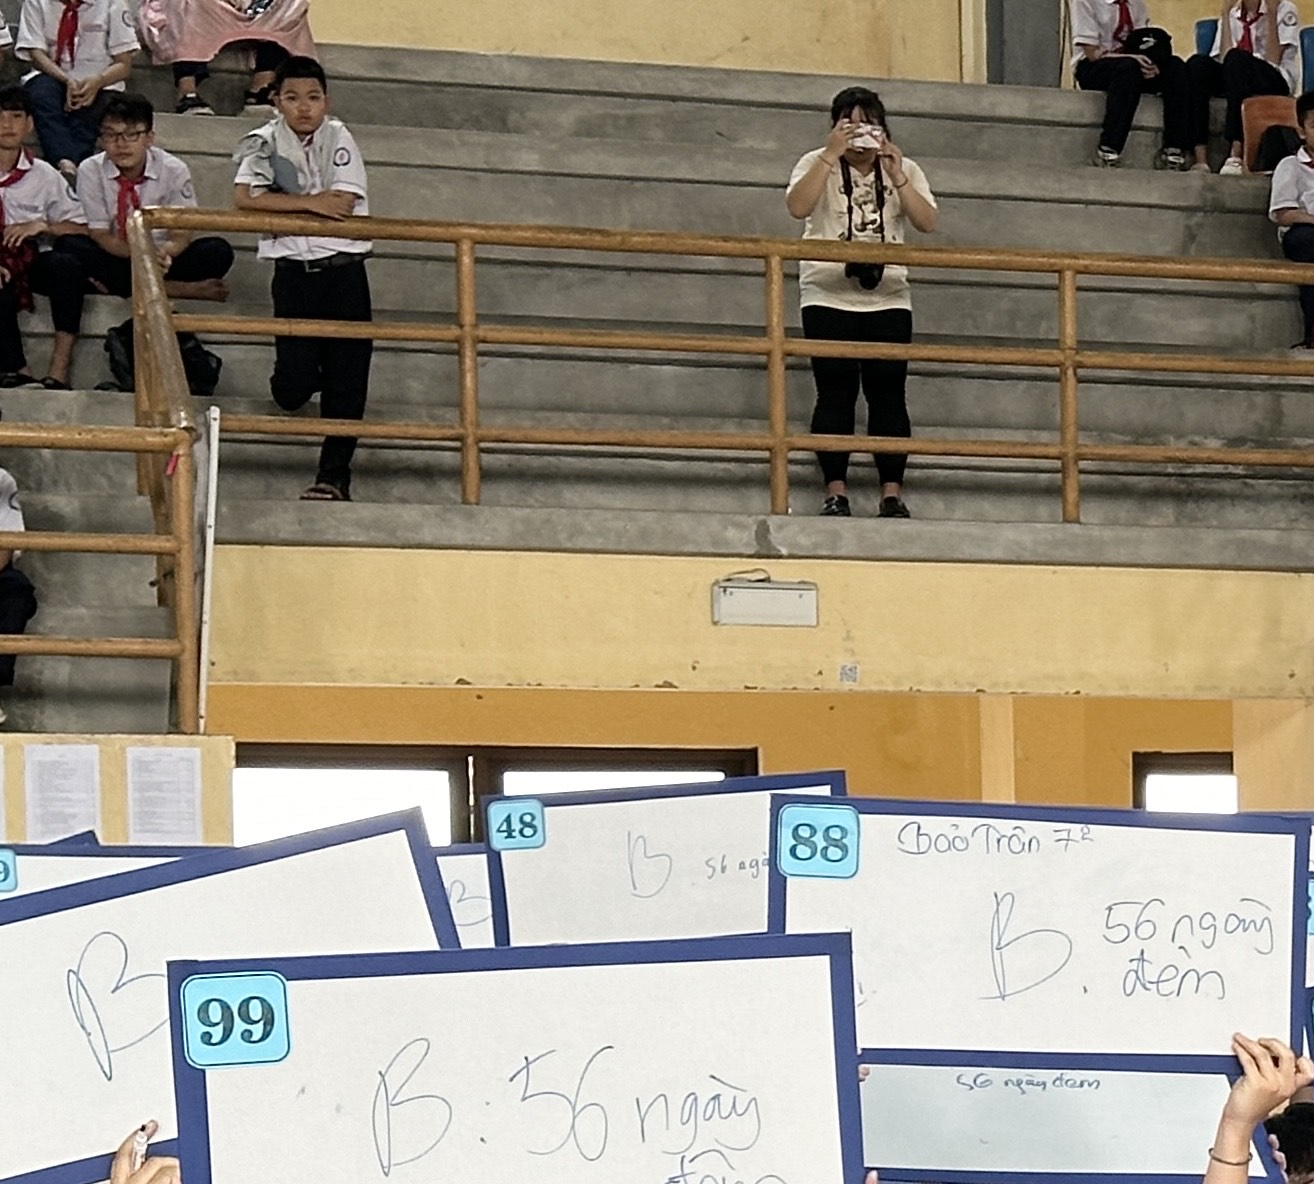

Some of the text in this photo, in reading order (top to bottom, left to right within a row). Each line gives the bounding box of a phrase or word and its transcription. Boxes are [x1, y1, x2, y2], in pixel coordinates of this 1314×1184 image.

[495, 812, 539, 839] 48
[788, 822, 850, 863] 88
[628, 831, 672, 898] B
[738, 854, 769, 879] ngà
[1103, 898, 1166, 944] 56
[196, 995, 276, 1047] 99
[508, 1045, 614, 1161] 56
